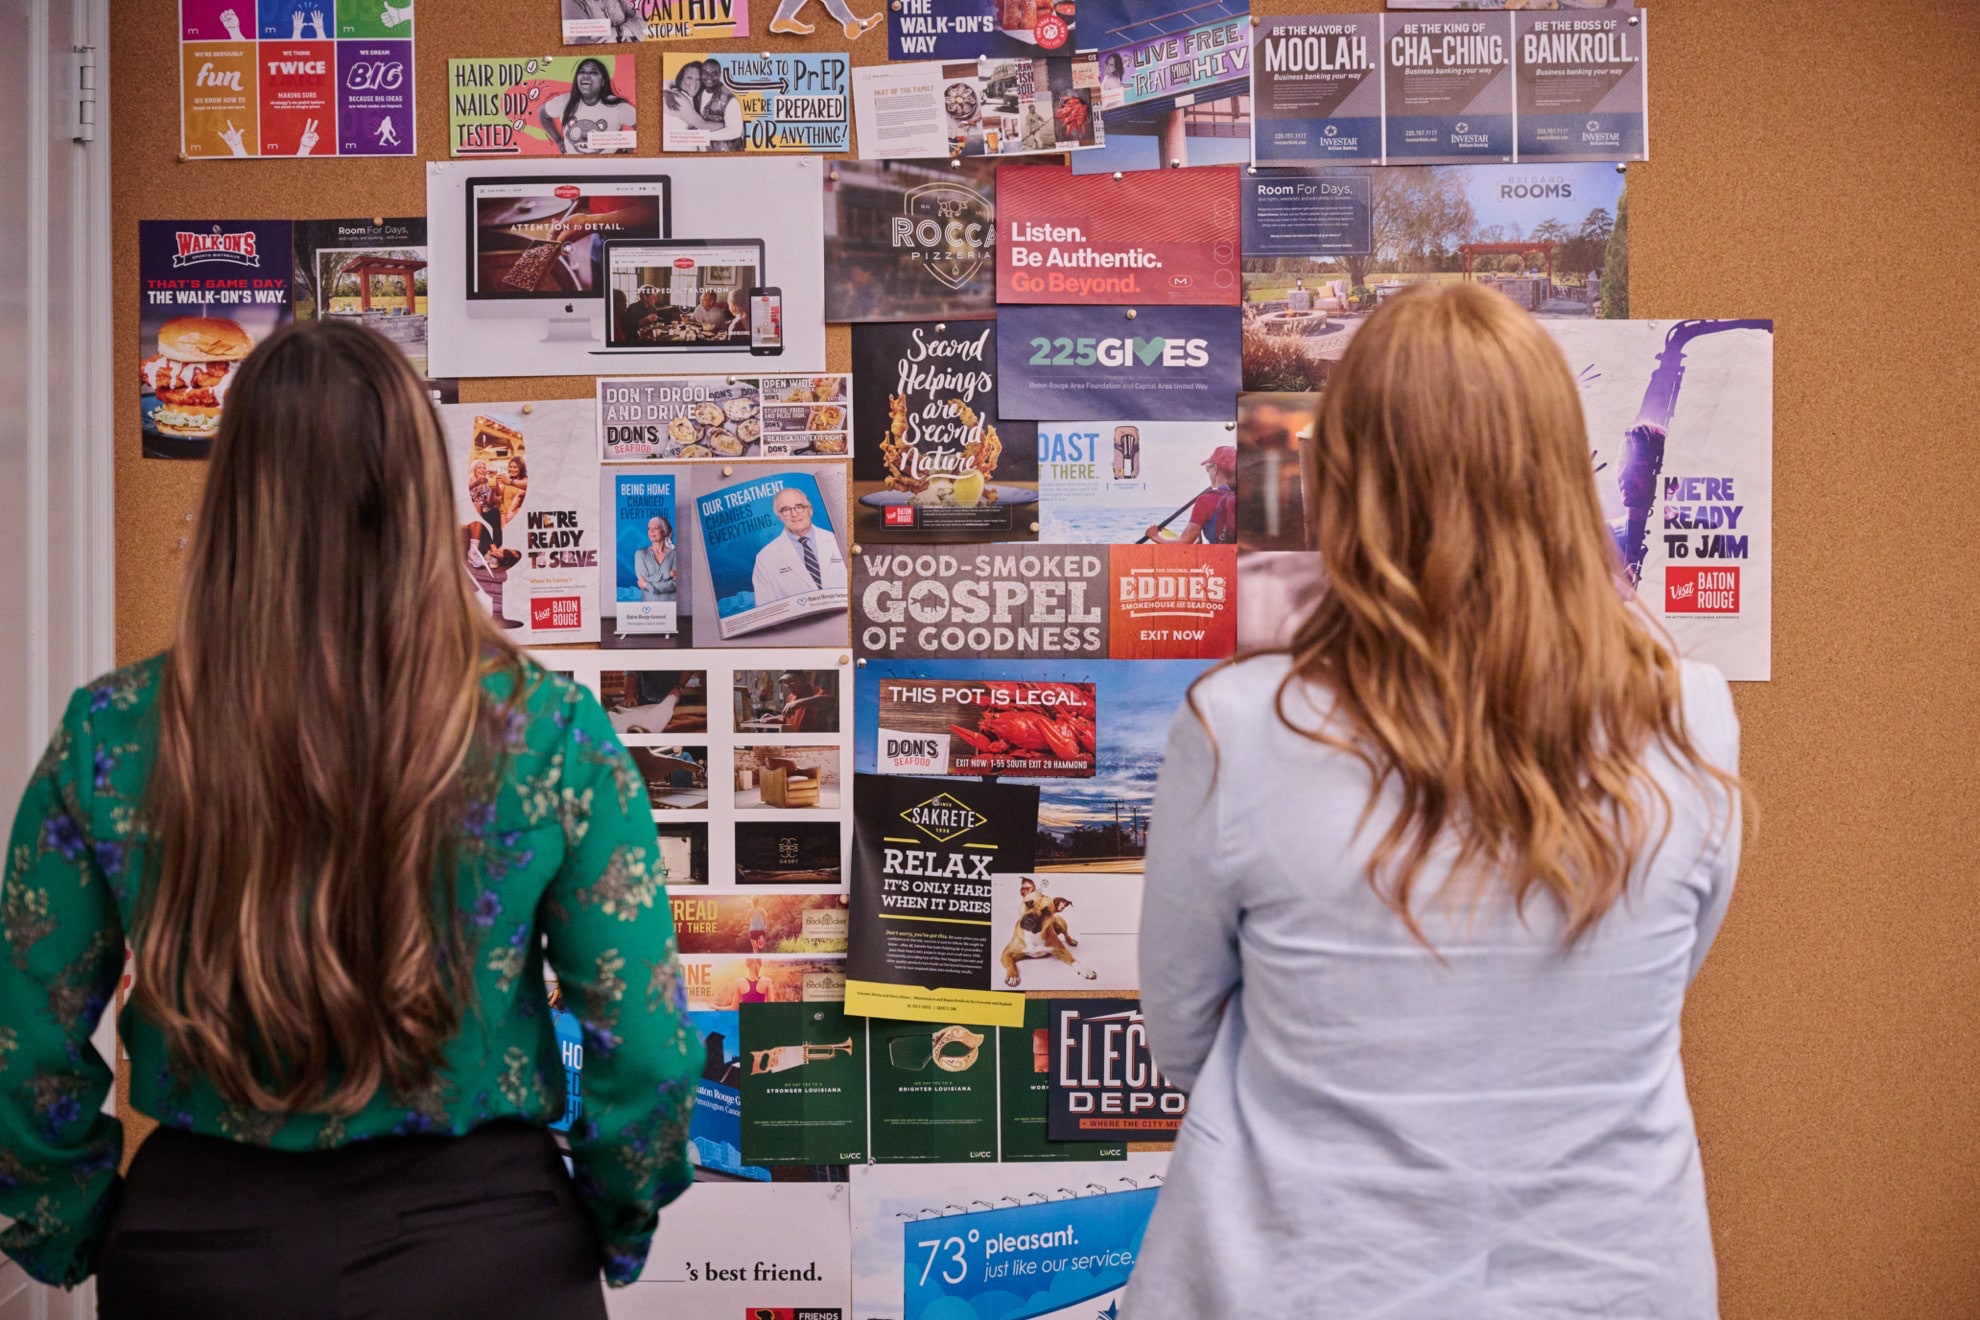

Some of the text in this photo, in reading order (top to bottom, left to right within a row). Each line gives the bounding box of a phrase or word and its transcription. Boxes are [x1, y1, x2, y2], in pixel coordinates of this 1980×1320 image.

[901, 0, 932, 14] THE
[648, 23, 673, 38] STOP
[901, 16, 994, 33] WALK-ON'S
[1273, 25, 1357, 36] BE THE MAYOR OF
[1404, 23, 1486, 34] BE THE KING OF
[1535, 20, 1617, 31] BE THE BOSS OF
[901, 36, 937, 53] WAY
[1133, 23, 1244, 68] LIVE FREE.
[1265, 36, 1376, 72] MOOLAH.
[1391, 35, 1509, 66] CHA-CHING.
[1524, 32, 1639, 64] BANKROLL.
[196, 62, 244, 91] fun
[268, 60, 326, 75] TWICE
[347, 61, 403, 90] BIG
[455, 63, 528, 87] HAIR DID.
[731, 60, 789, 76] THANKS TO
[1132, 67, 1168, 96] TREAT
[1171, 61, 1191, 80] YOUR
[455, 93, 533, 116] NAILS DID.
[743, 98, 842, 118] WE'RE PREPARED
[456, 123, 518, 147] TESTED.
[744, 120, 848, 149] FOR ANYTHING!
[1320, 137, 1357, 146] INVESTAR
[1257, 185, 1294, 195] Room
[1297, 184, 1317, 194] For
[1500, 183, 1572, 198] ROOMS
[338, 227, 365, 235] Room
[367, 226, 382, 234] For
[510, 224, 570, 232] ATTENTION
[584, 223, 625, 231] DETAIL.
[892, 217, 997, 248] ROCCA
[1011, 221, 1087, 243] Listen.
[911, 251, 991, 260] PIZZERIA
[1011, 247, 1163, 268] Be Authentic.
[147, 279, 287, 289] THAT'S GAME DAY.
[1011, 272, 1141, 296] Go Beyond.
[147, 290, 287, 304] THE WALK-ON'S WAY.
[907, 328, 990, 362] Second
[897, 358, 993, 403] Helpings
[606, 387, 712, 403] DON'T DROOL
[606, 404, 697, 421] AND DRIVE
[922, 400, 963, 420] are
[607, 426, 659, 445] DON'S
[901, 412, 985, 445] Second
[614, 445, 652, 454] SEAFOOD
[1051, 464, 1099, 479] THERE.
[621, 483, 671, 496] BEING HOME
[702, 480, 785, 516] OUR TREATMENT
[1664, 477, 1735, 501] WE'RE
[527, 511, 578, 530] WE'RE
[705, 504, 753, 532] CHANGES
[1664, 506, 1744, 529] READY
[527, 530, 584, 549] READY
[708, 514, 777, 546] EVERYTHING.
[1695, 535, 1748, 559] JAM
[549, 550, 598, 569] SERVE
[864, 555, 1101, 577] WOOD-SMOKED
[1698, 572, 1735, 590] BATON
[1669, 582, 1696, 600] Visit
[1698, 591, 1735, 608] ROUGE
[552, 600, 578, 613] BATON
[862, 580, 1101, 623] GOSPEL
[1121, 602, 1175, 610] SMOKEHOUSE
[1187, 602, 1223, 610] SEAFOOD
[553, 613, 578, 626] ROUGE
[862, 627, 1101, 650] OF GOODNESS
[1140, 630, 1205, 640] EXIT NOW
[889, 687, 1087, 706] THIS POT IS LEGAL.
[887, 739, 939, 758] DON'S
[893, 757, 930, 767] SEAFOOD
[955, 758, 970, 768] EXIT
[971, 758, 989, 768] NOW:
[1007, 759, 1027, 769] SOUTH
[1028, 760, 1042, 769] EXIT
[1053, 760, 1088, 769] HAMMOND
[912, 807, 976, 828] SAKRETE
[882, 849, 993, 880] RELAX
[884, 879, 992, 898] IT'S ONLY HARD
[881, 895, 991, 914] WHEN IT DRIES
[1069, 1092, 1186, 1114] DEPO
[986, 1225, 1079, 1259] pleasant.
[705, 1261, 747, 1282] best
[753, 1261, 822, 1282] friend.
[984, 1249, 1135, 1282] just like our service.
[799, 1312, 839, 1320] FRIENDS
